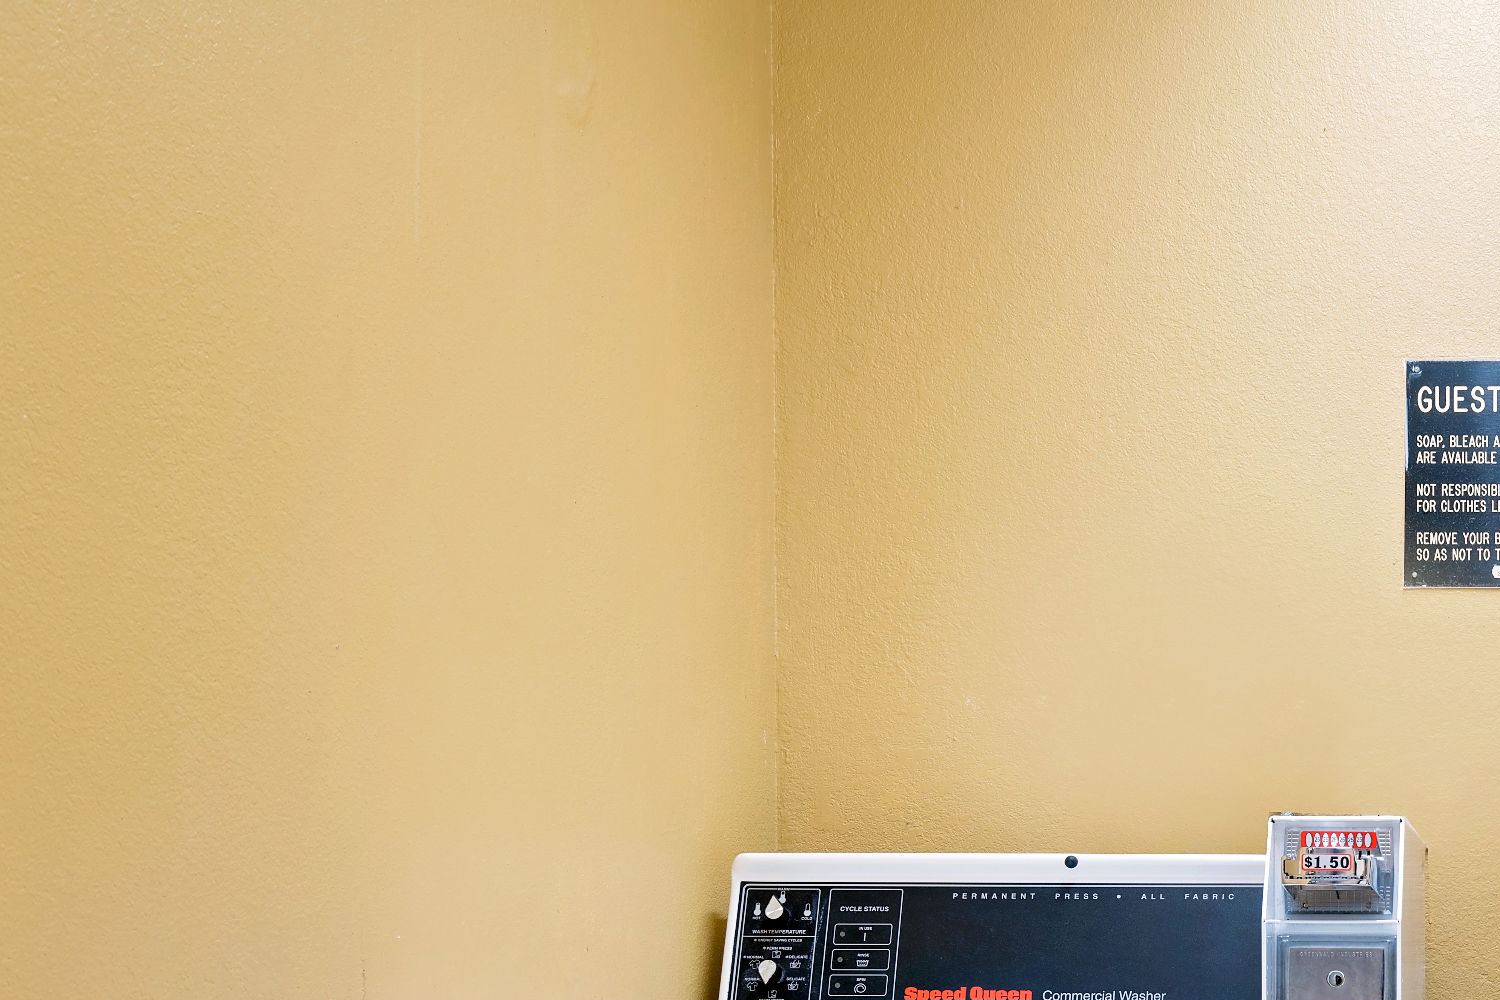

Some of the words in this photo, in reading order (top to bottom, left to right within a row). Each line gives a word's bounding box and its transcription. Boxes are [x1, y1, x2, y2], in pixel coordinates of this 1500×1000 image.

[1416, 435, 1445, 448] SOAP,
[1449, 435, 1488, 448] BLEACH
[1416, 451, 1436, 464] ARE
[1441, 451, 1497, 464] AVAILABLE
[1416, 484, 1436, 496] NOT
[1416, 500, 1436, 512] FOR
[1441, 500, 1486, 512] CLOTHES
[1416, 532, 1458, 545] REMOVE
[1463, 532, 1490, 545] YOUR
[1416, 548, 1430, 561] SO
[1434, 548, 1447, 561] AS
[1452, 548, 1472, 561] NOT
[1477, 548, 1490, 561] TO
[1304, 856, 1350, 868] $1.50
[952, 892, 1037, 900] PERMANENT
[1055, 892, 1100, 900] PRESS
